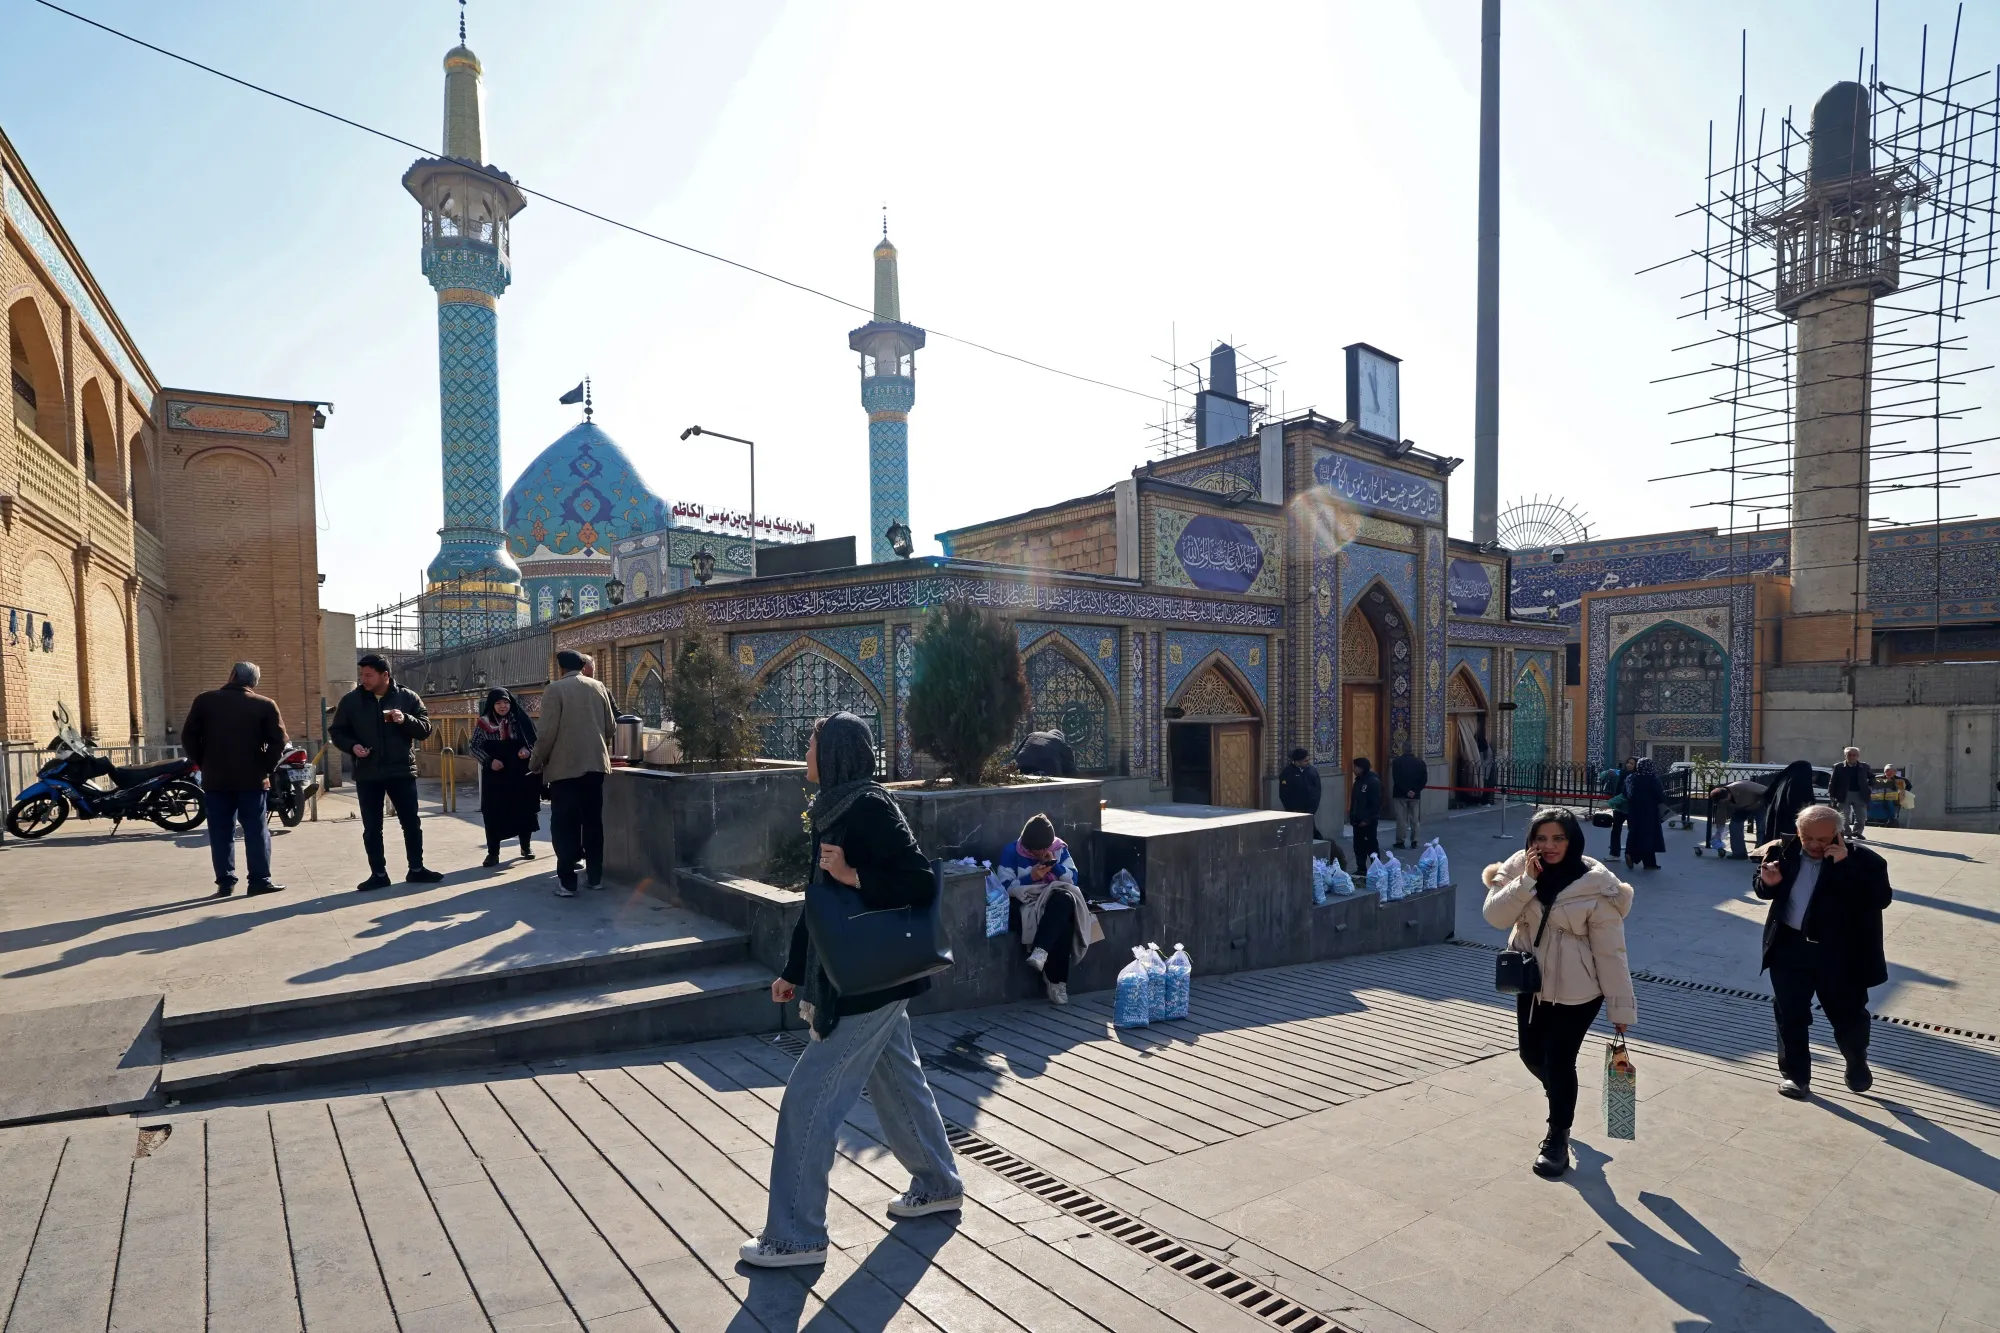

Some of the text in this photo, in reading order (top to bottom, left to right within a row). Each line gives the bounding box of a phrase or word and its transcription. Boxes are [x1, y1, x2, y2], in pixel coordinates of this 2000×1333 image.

[672, 501, 704, 519] الکاظم
[773, 516, 793, 535] علیک
[793, 520, 815, 536] السلام
